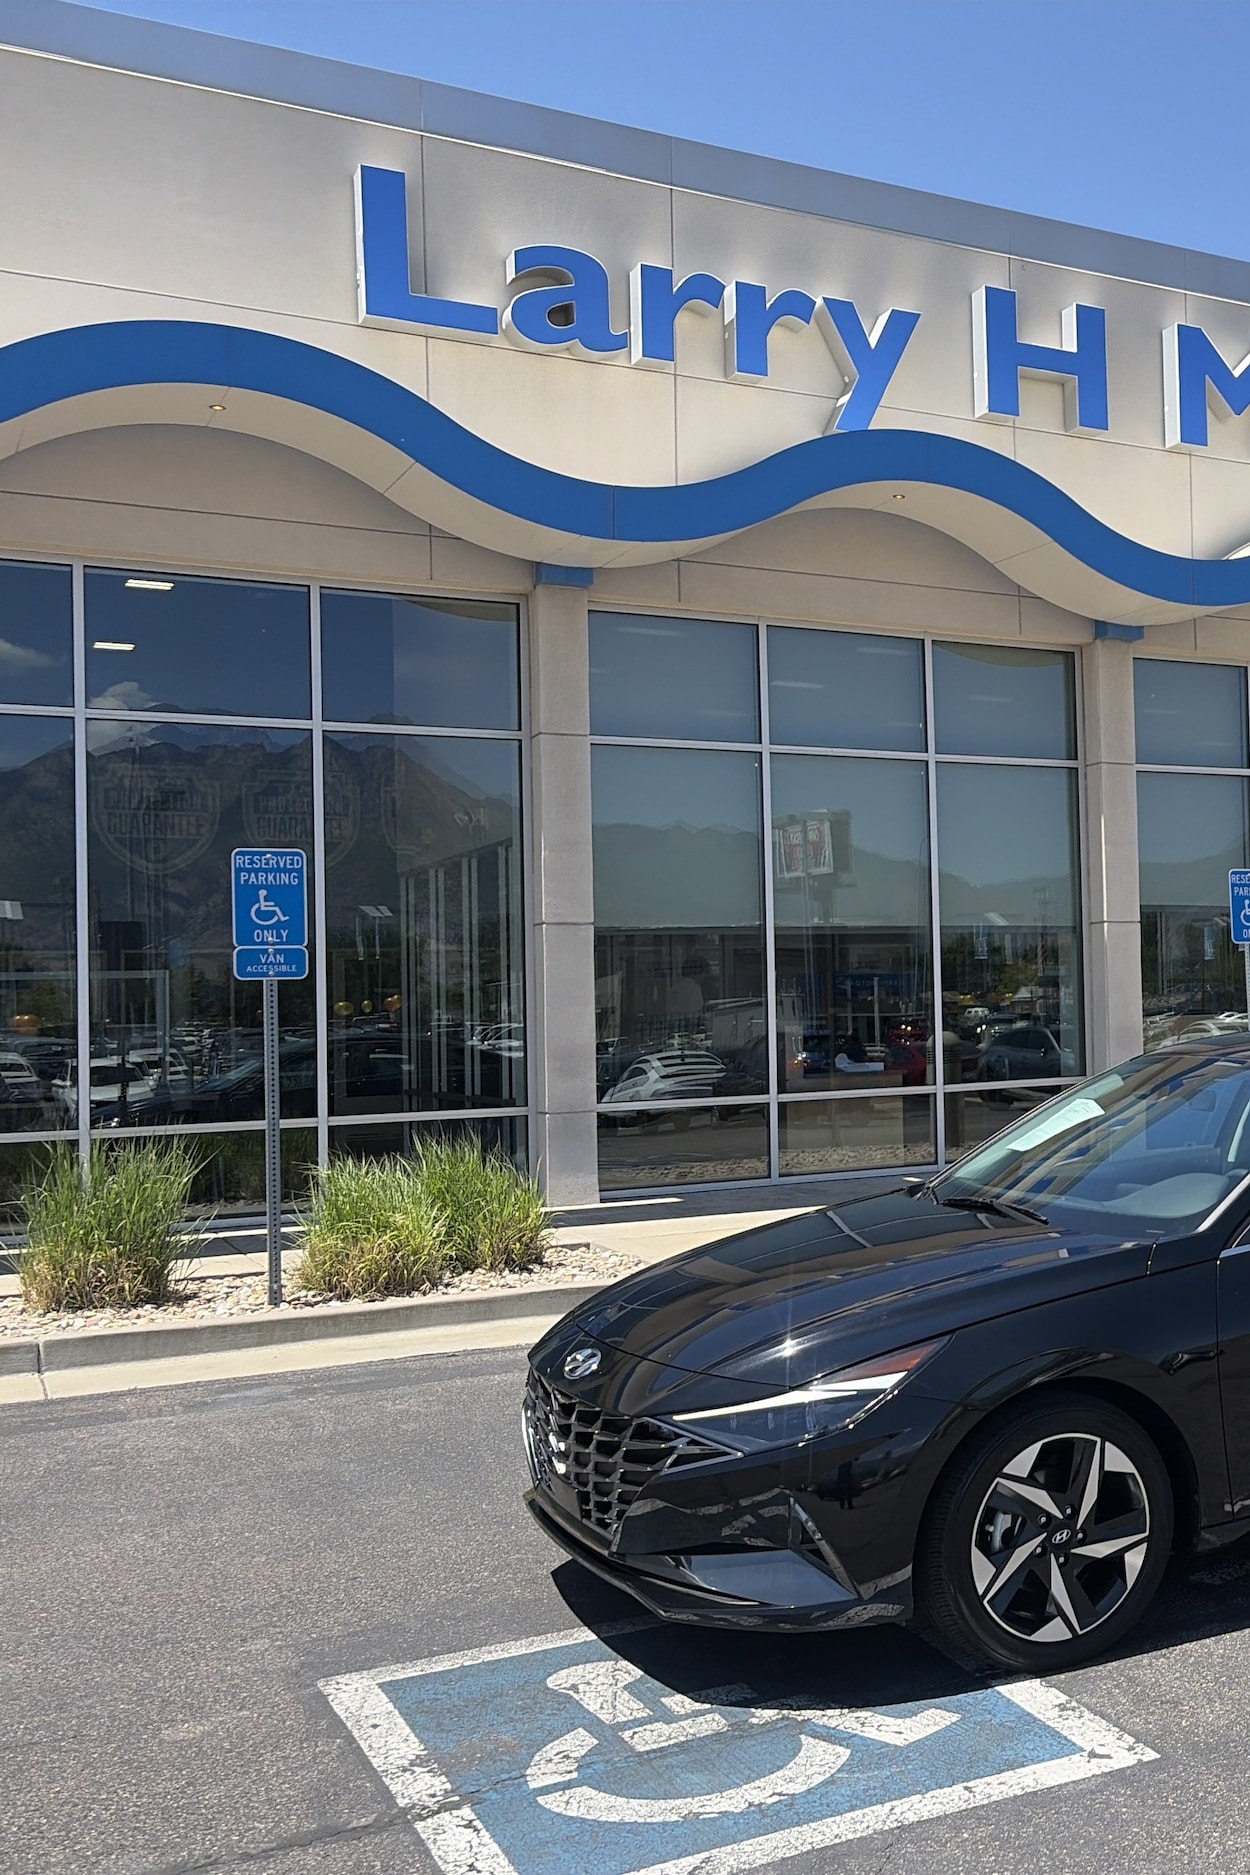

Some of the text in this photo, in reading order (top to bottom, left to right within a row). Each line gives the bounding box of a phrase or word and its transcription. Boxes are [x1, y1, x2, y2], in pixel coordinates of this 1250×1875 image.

[354, 163, 922, 434] Larry
[971, 283, 1109, 436] H
[235, 855, 302, 868] RESERVED
[240, 872, 299, 885] PARKING
[254, 929, 289, 942] ONLY
[259, 953, 285, 964] VAN
[246, 964, 297, 972] ACCESSIBLE
